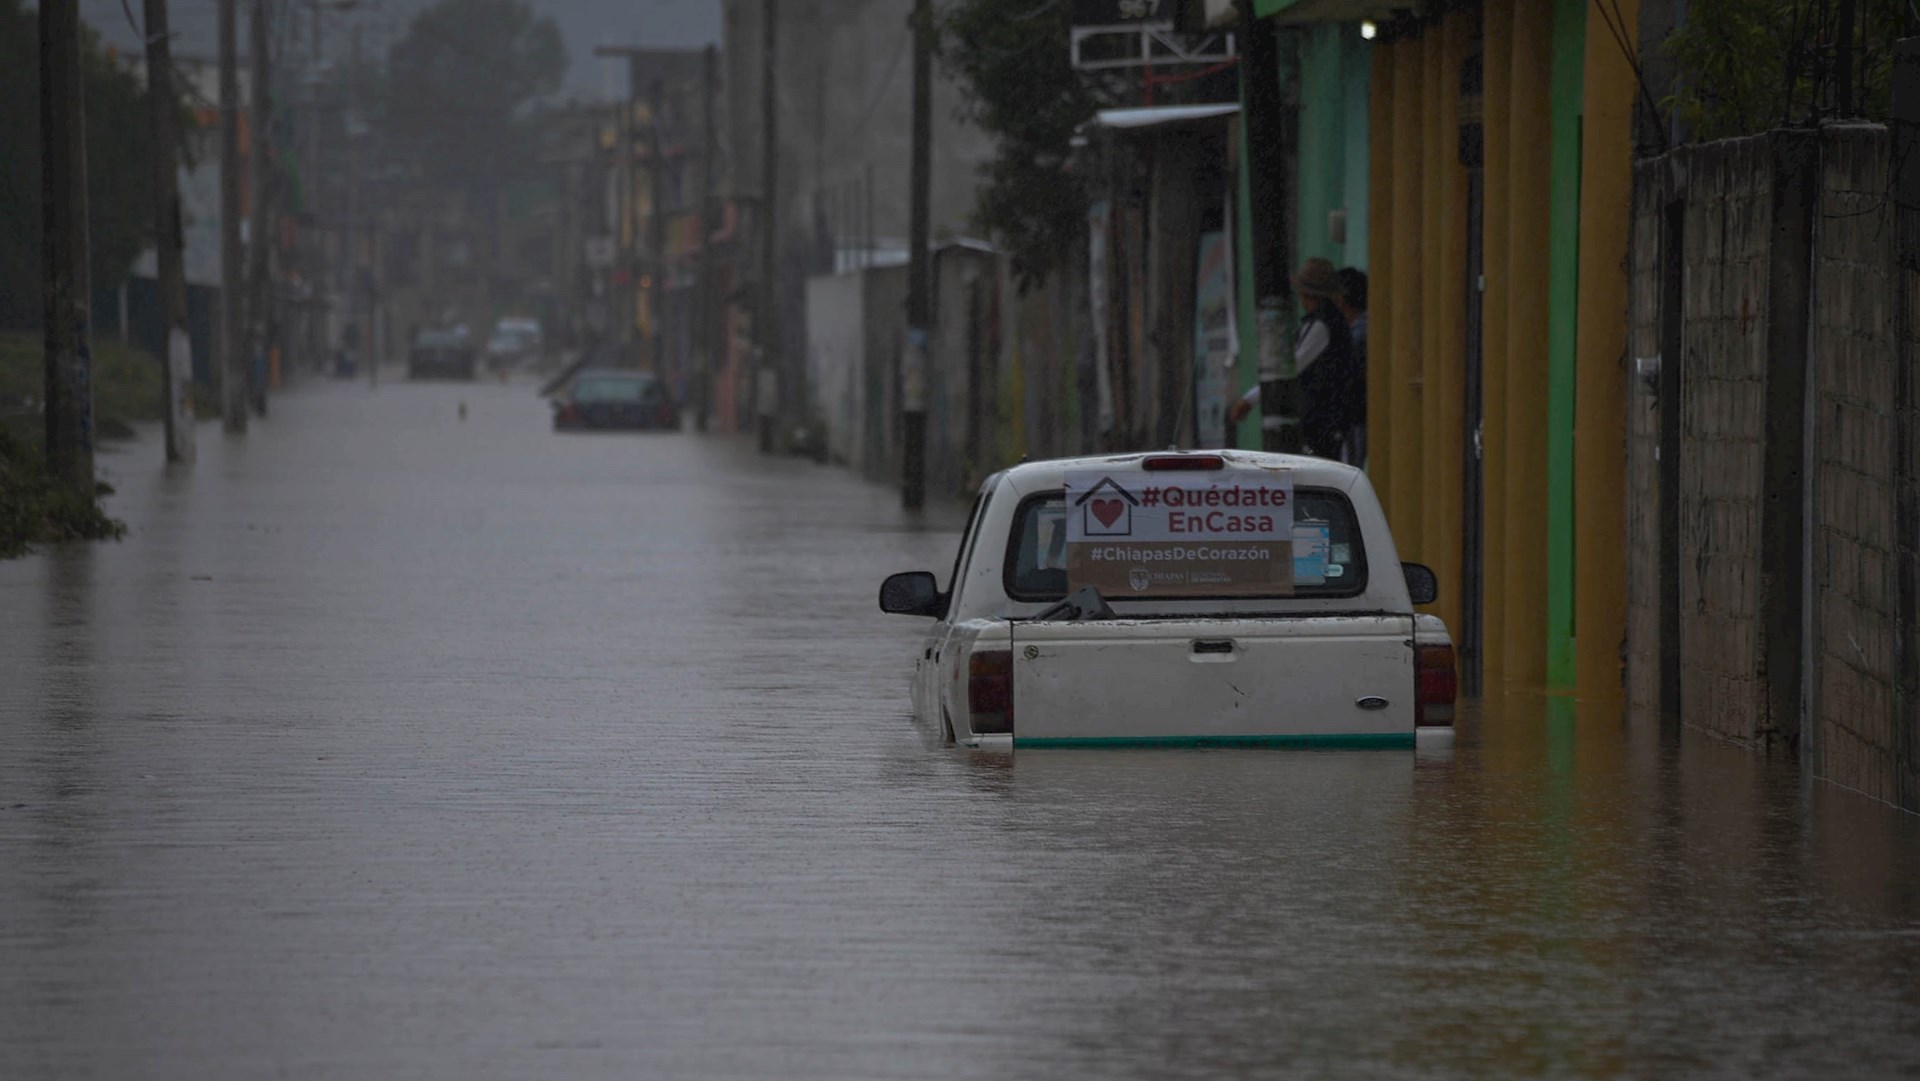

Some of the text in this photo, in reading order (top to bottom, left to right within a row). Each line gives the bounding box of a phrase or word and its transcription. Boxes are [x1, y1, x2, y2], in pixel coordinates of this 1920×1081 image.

[1141, 484, 1287, 507] #Quédate
[1168, 511, 1274, 533] EnCasa
[1090, 546, 1270, 563] #ChiapasDeCorazón
